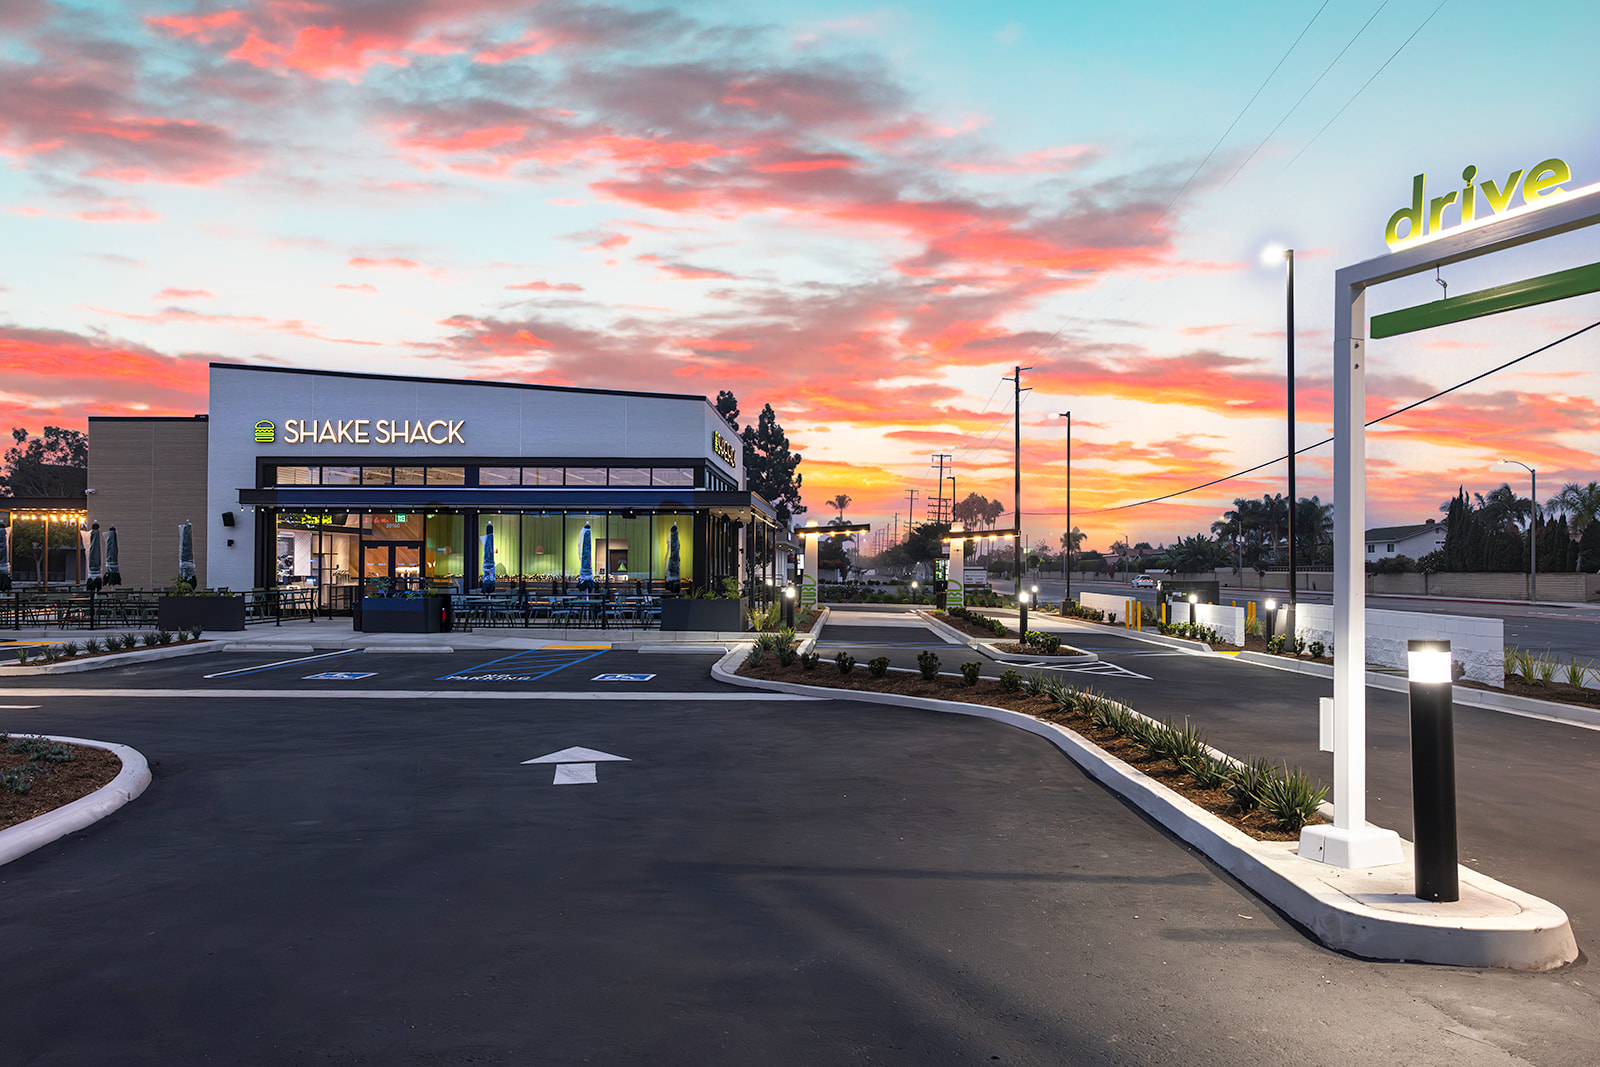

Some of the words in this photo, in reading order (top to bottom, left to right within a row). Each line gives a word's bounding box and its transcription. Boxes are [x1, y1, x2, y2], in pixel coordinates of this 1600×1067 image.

[1385, 158, 1571, 252] drive
[284, 419, 370, 444] SHAKE
[375, 419, 465, 444] SHACK
